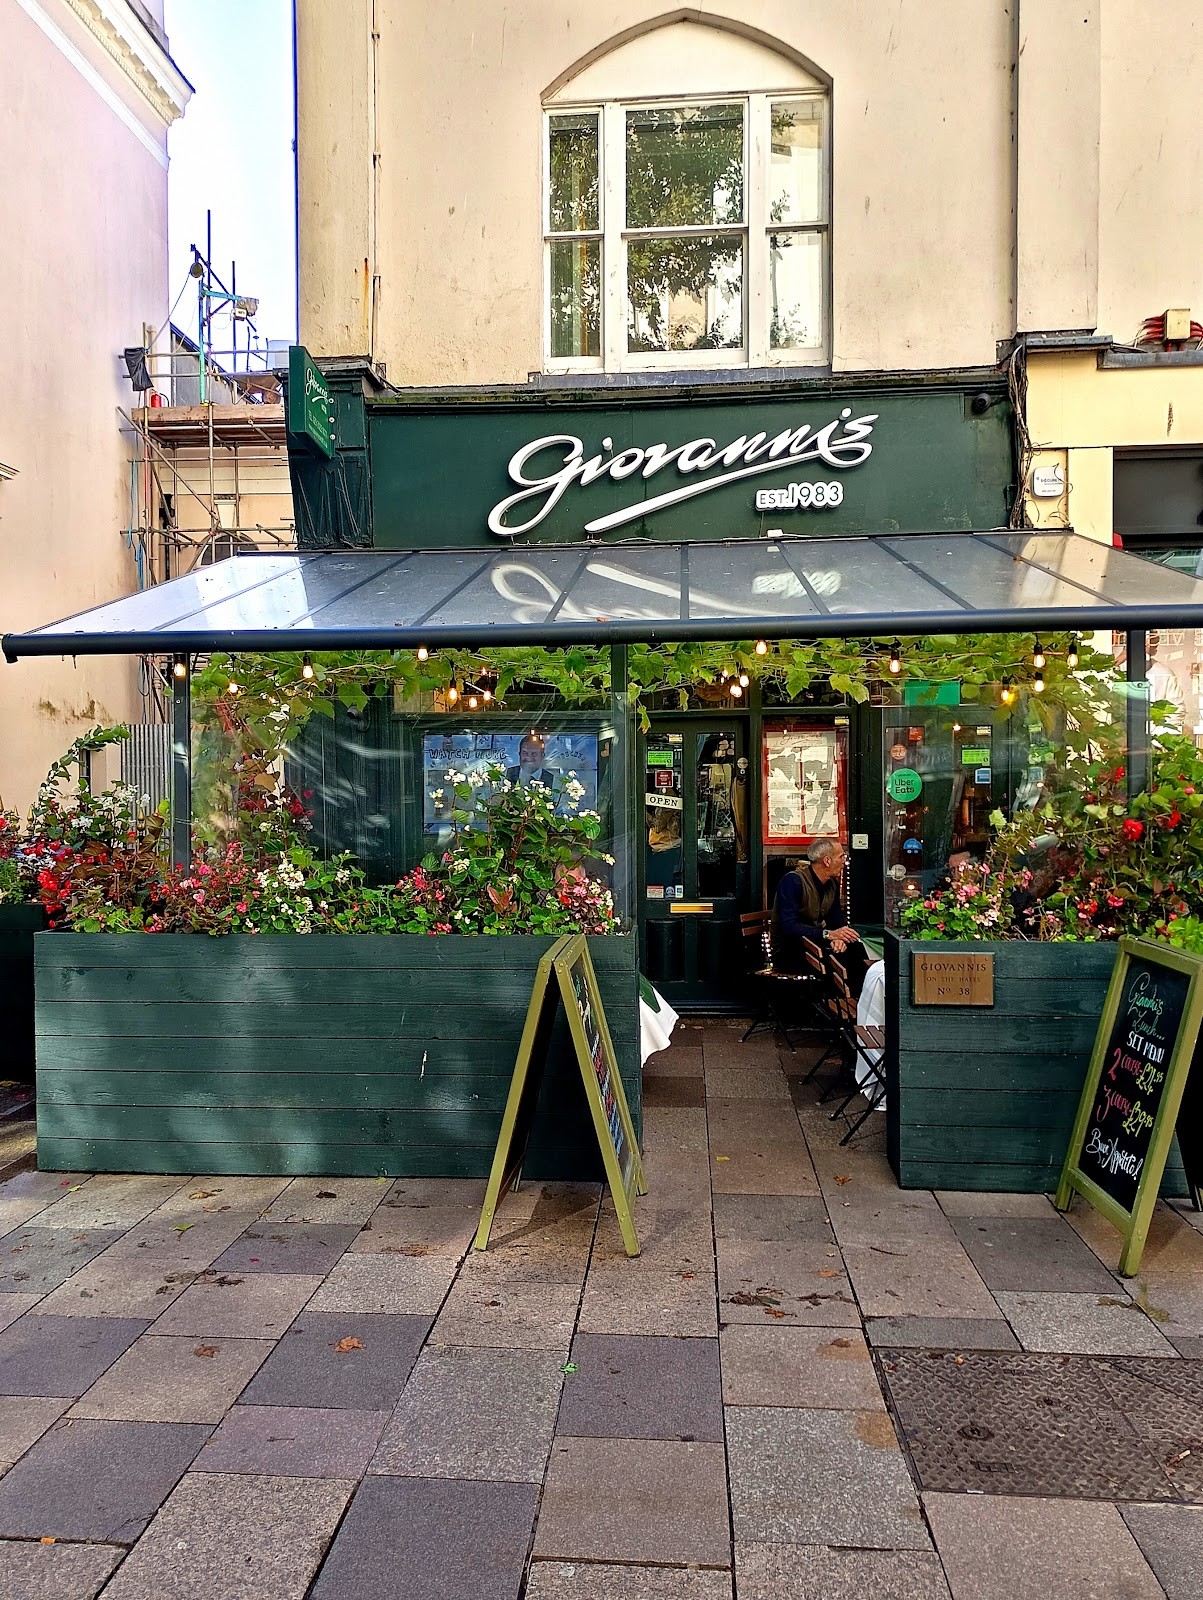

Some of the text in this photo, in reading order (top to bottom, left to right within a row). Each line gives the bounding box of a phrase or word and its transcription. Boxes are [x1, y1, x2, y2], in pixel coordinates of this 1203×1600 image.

[789, 484, 840, 505] 1983
[429, 748, 471, 760] WATCH
[894, 778, 915, 786] Uber
[895, 786, 915, 794] Eats
[649, 796, 679, 807] OPEN
[920, 963, 987, 972] GIOVANNIS
[958, 987, 970, 996] 38
[1126, 1031, 1165, 1065] SET MENU
[1108, 1048, 1122, 1081] 2
[1097, 1085, 1111, 1122] 3
